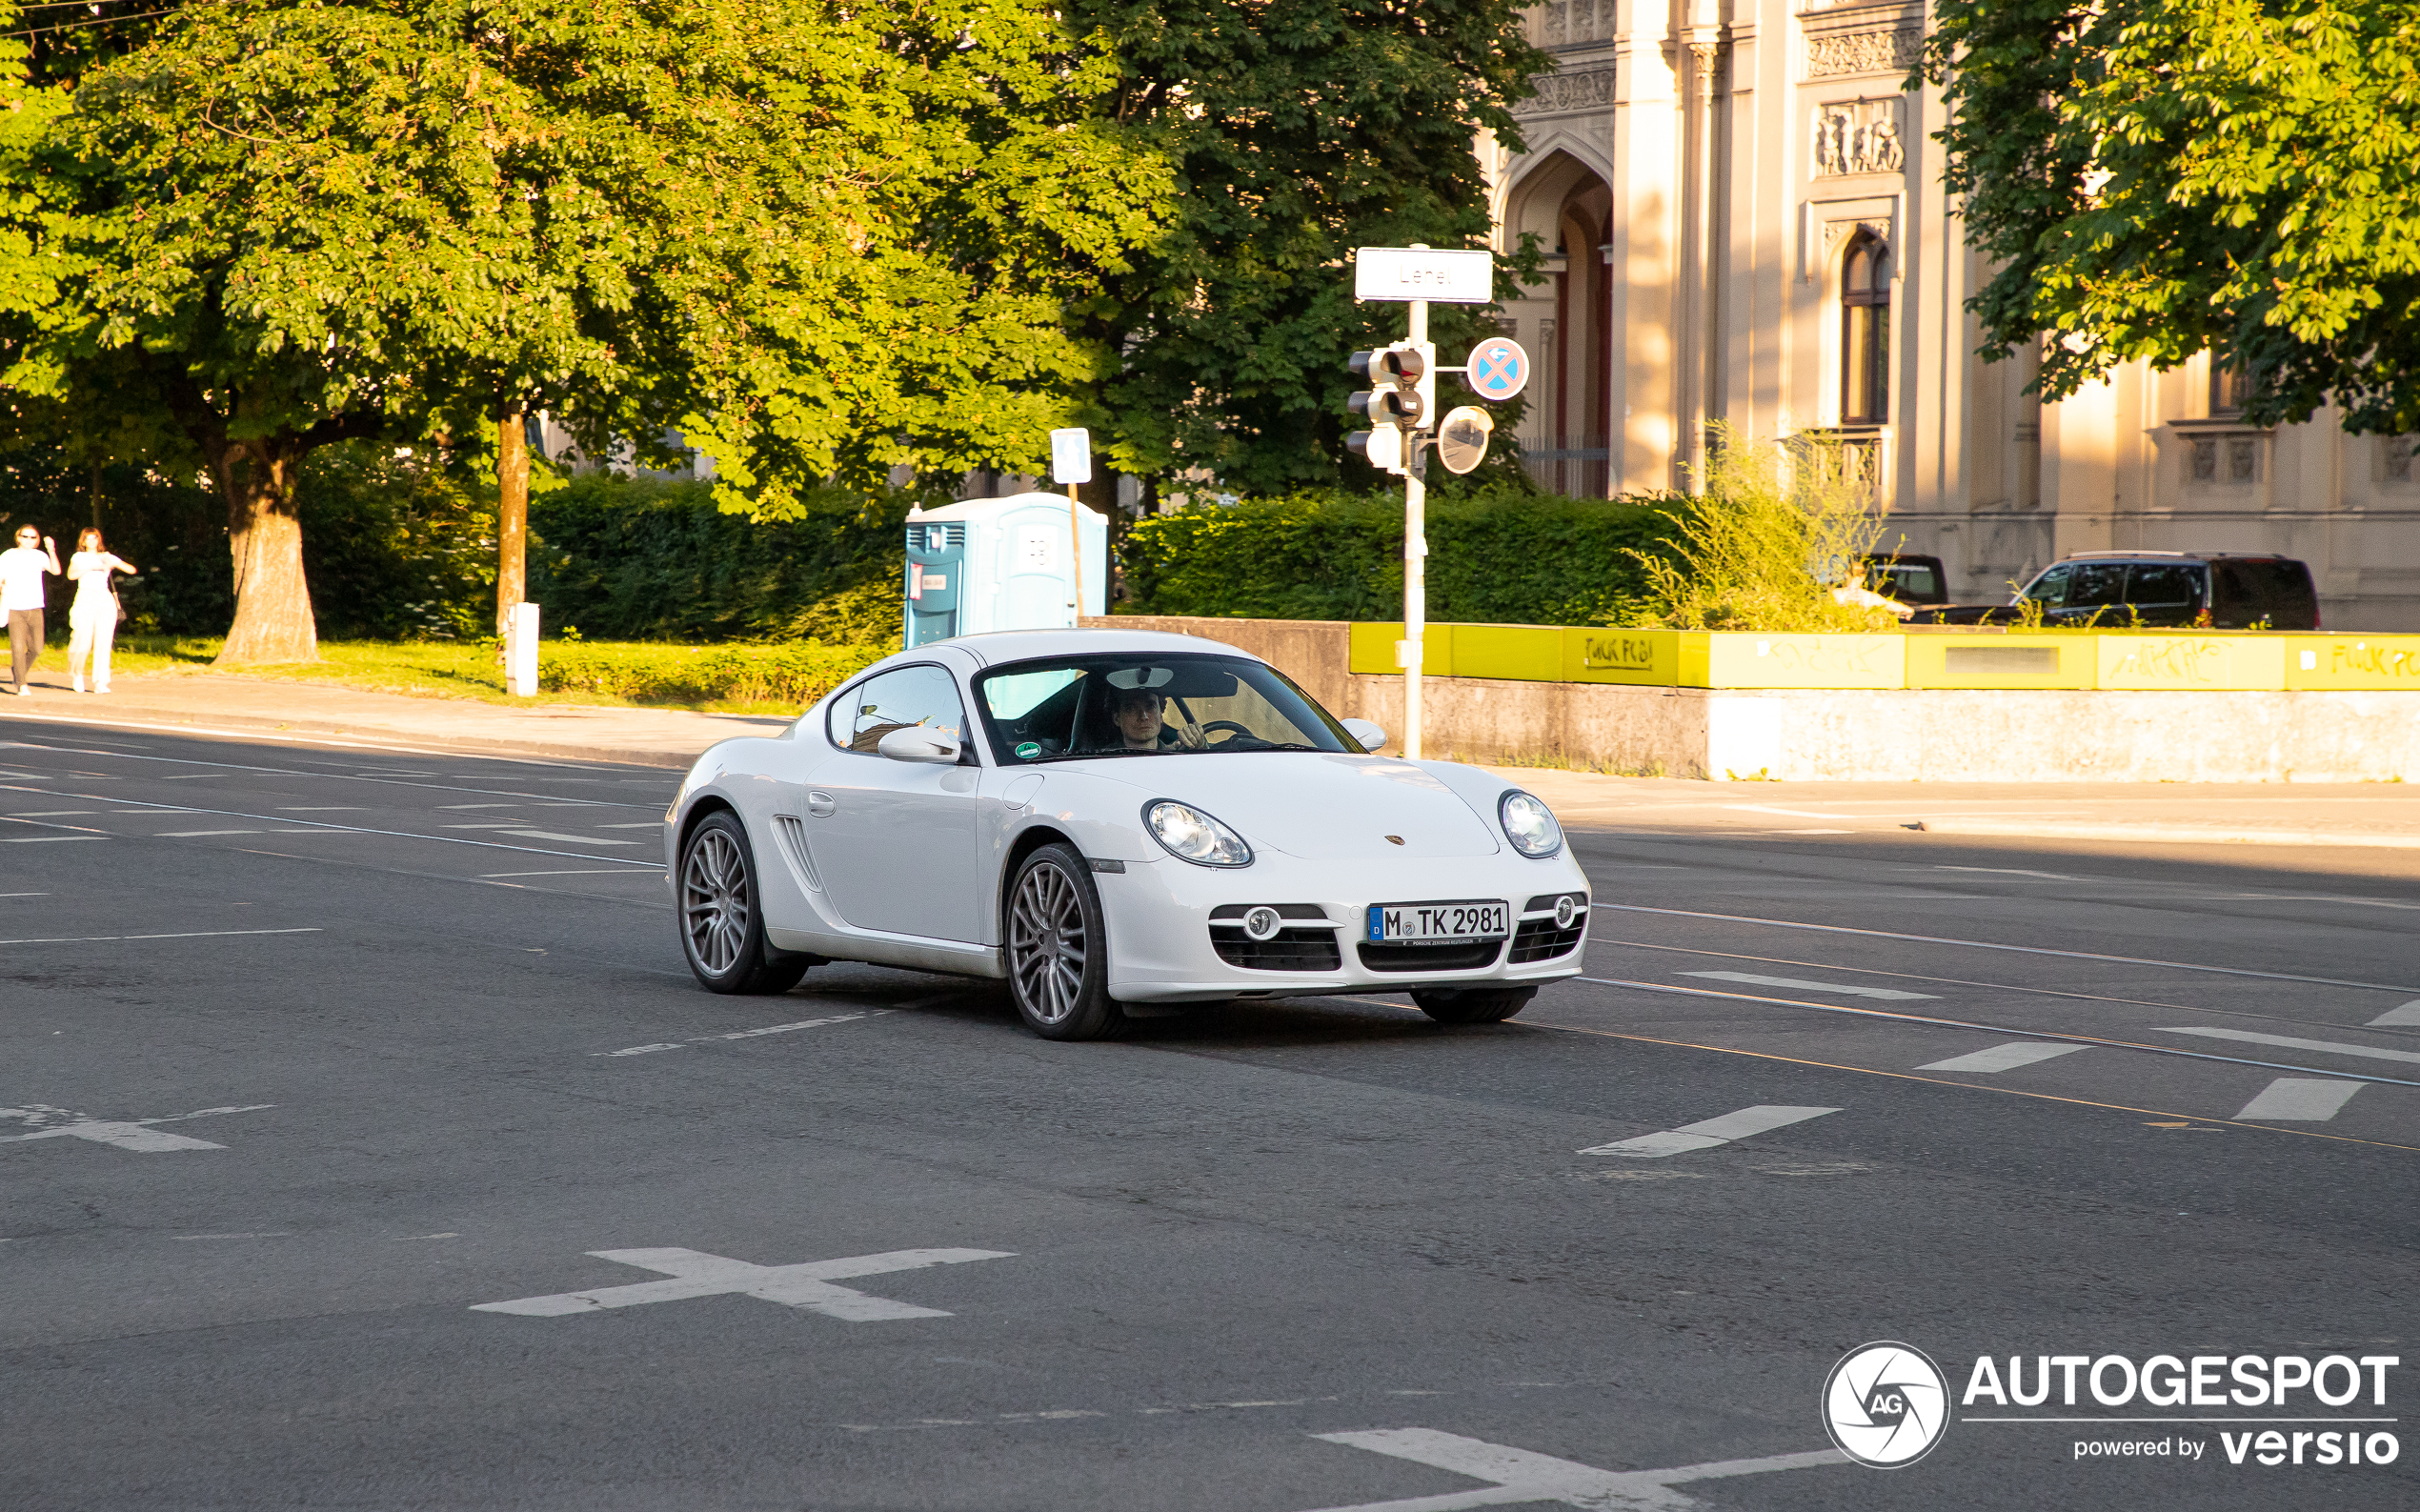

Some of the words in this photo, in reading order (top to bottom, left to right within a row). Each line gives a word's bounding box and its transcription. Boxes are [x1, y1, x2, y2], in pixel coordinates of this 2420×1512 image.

[1400, 265, 1451, 284] Lehel
[1385, 911, 1401, 937] M
[1418, 909, 1447, 936] TK
[1453, 907, 1505, 935] 2981
